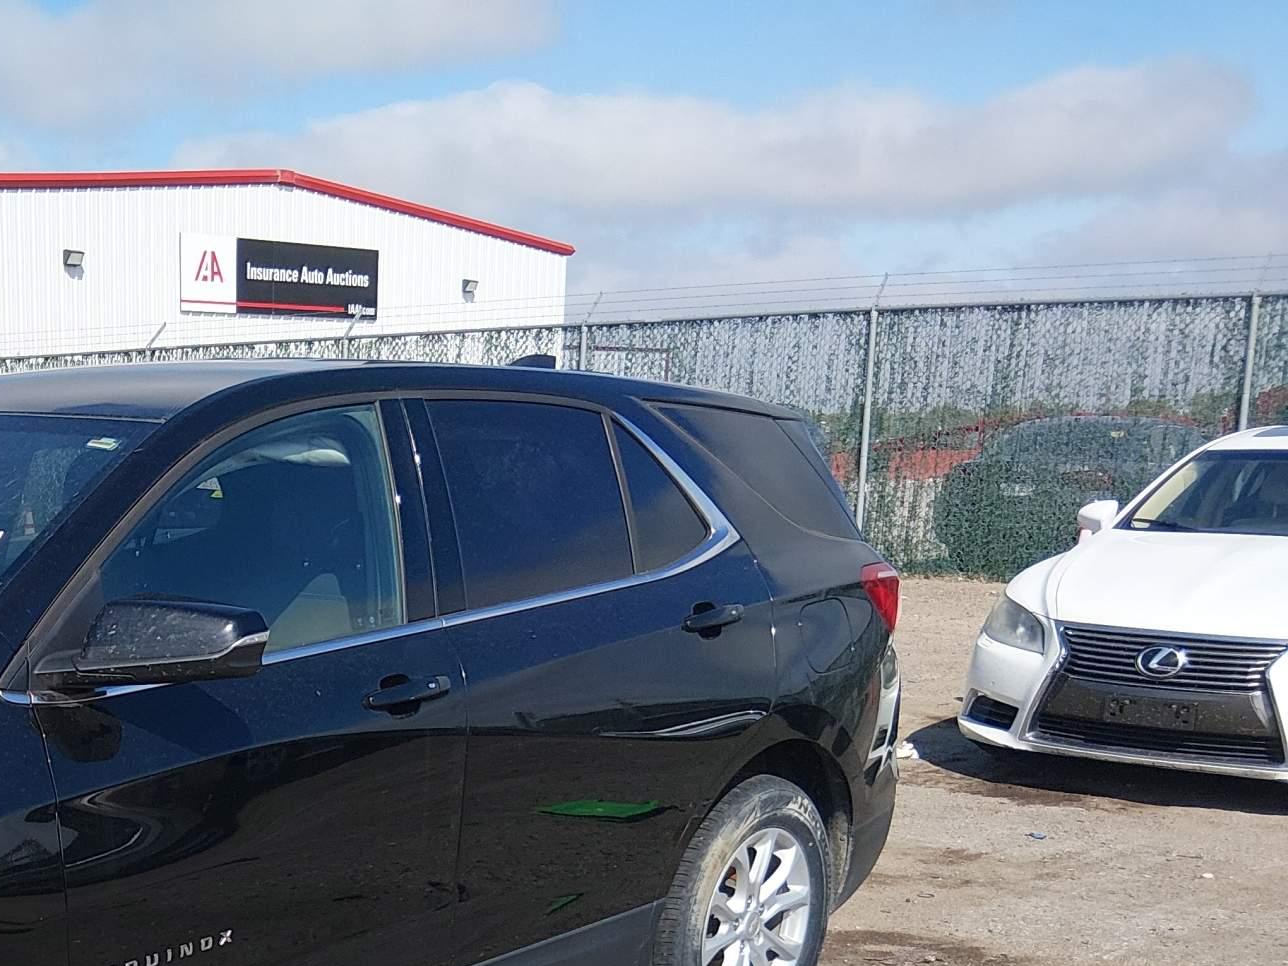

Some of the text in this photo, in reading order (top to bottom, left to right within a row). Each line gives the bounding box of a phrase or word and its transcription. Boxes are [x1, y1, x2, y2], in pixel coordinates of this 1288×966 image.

[246, 261, 369, 288] Insurance Auto Auctions
